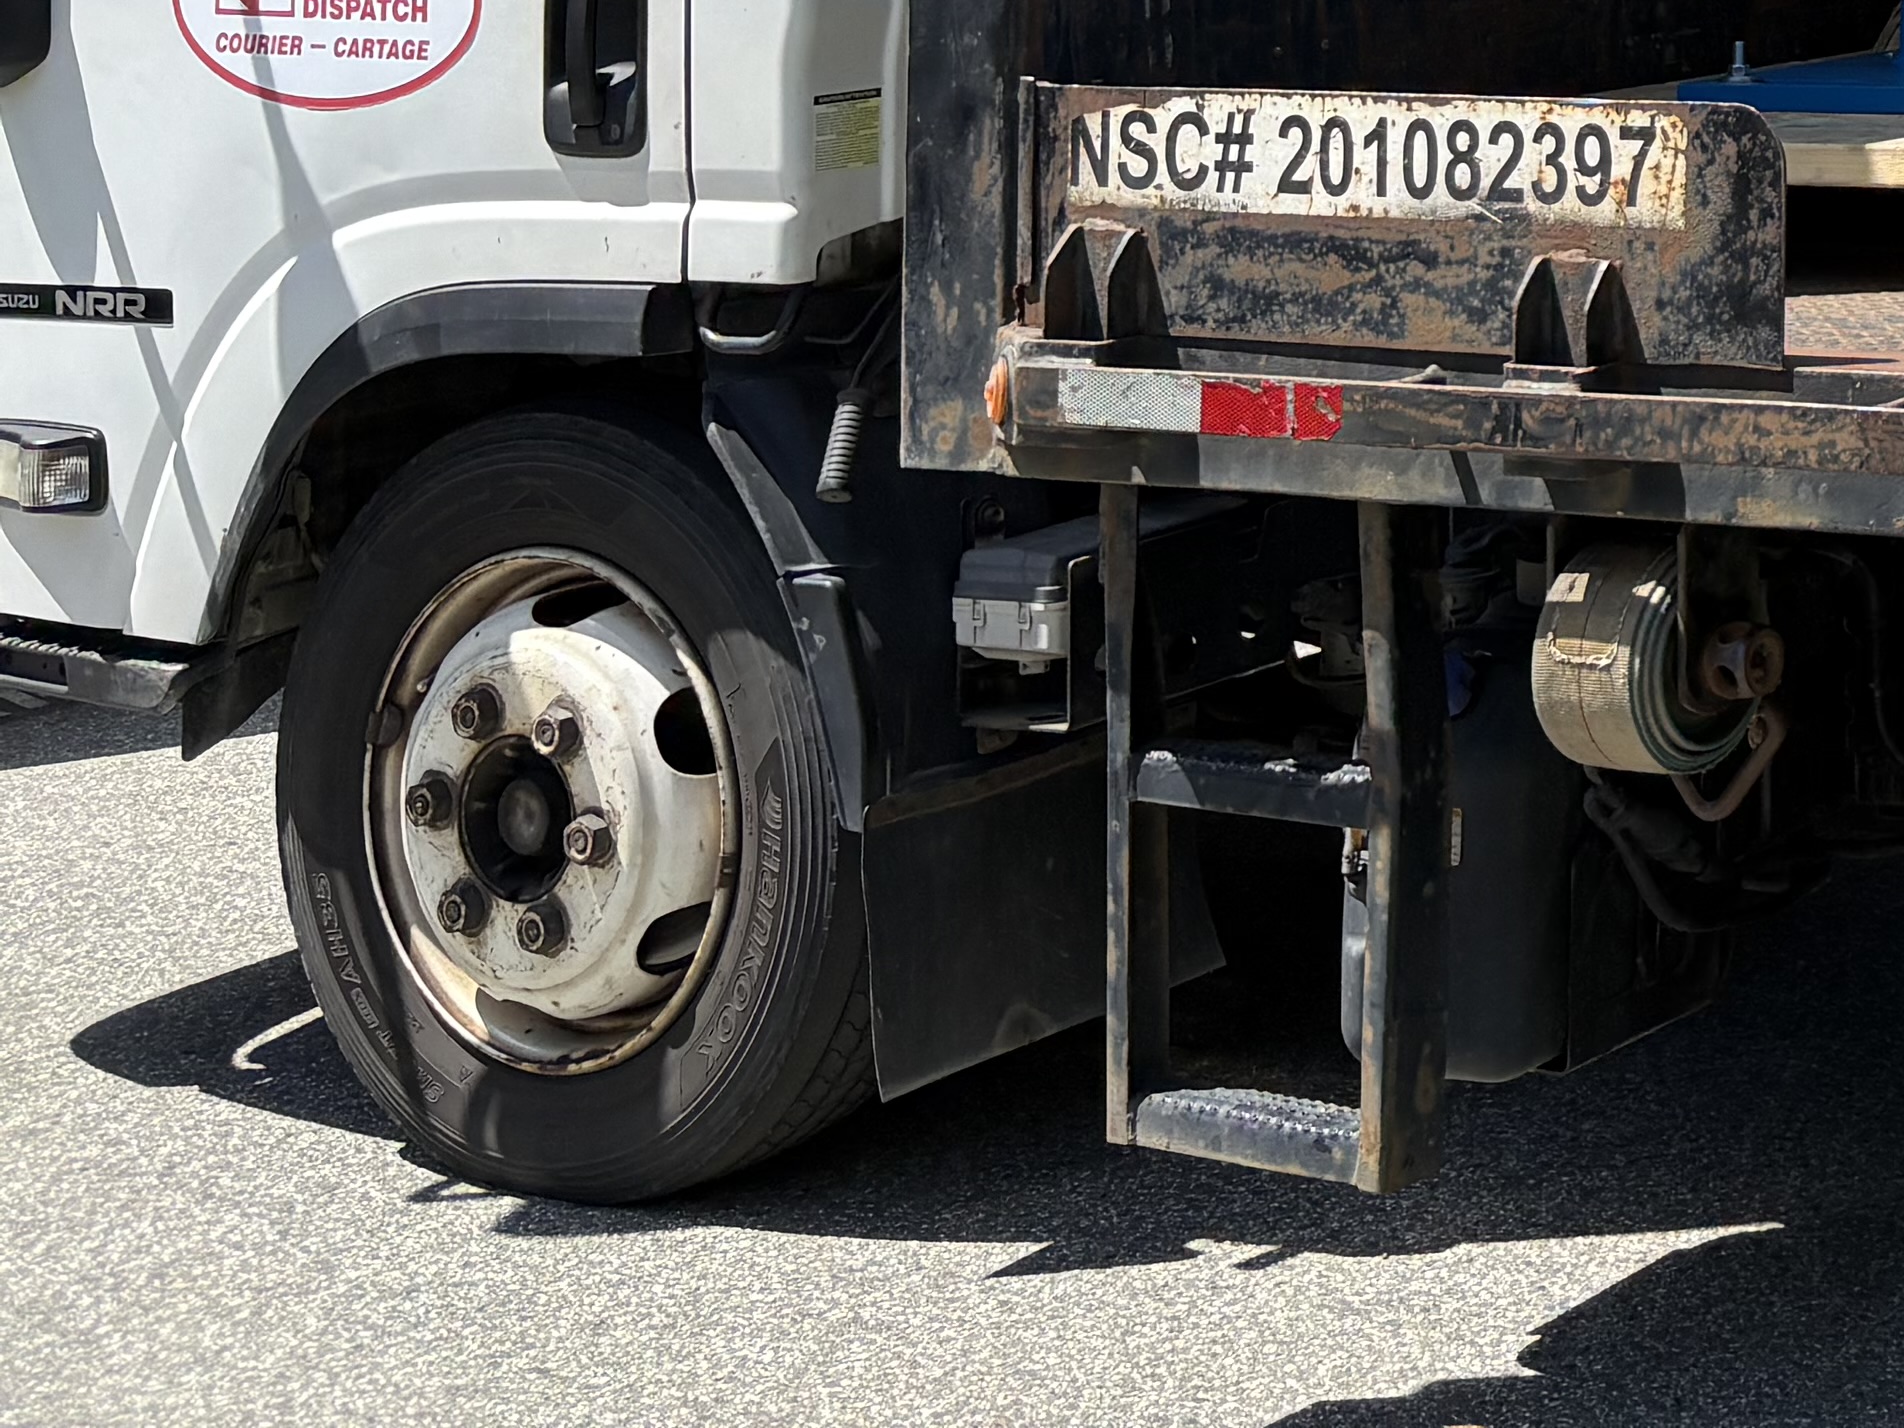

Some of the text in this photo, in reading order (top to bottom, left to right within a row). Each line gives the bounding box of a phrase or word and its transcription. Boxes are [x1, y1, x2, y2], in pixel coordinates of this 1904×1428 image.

[215, 31, 304, 57] COURIER
[332, 35, 431, 62] CARTAGE
[1068, 107, 1657, 209] NSC# 201082397
[0, 289, 146, 319] SUZU NRR
[310, 870, 363, 987] AH35
